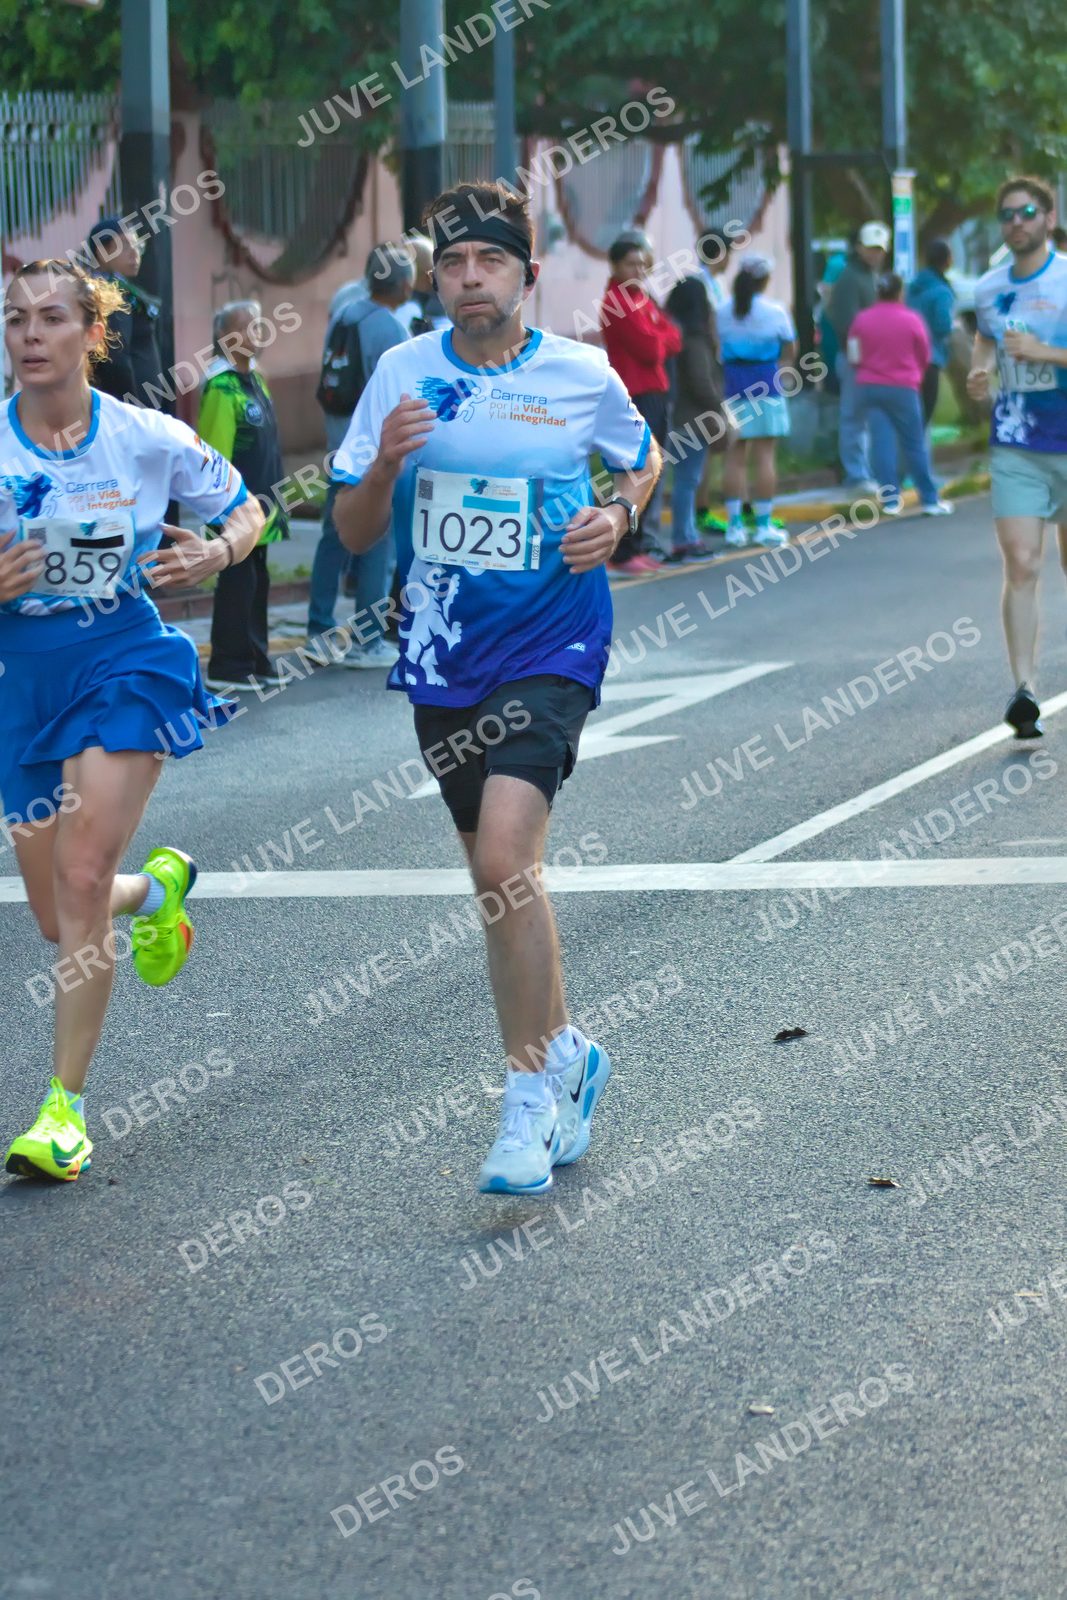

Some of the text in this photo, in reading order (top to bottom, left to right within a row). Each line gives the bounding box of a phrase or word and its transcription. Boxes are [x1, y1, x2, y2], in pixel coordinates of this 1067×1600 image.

[491, 388, 547, 404] Carrera
[490, 400, 548, 415] por la Vida
[497, 410, 506, 420] la
[510, 411, 567, 427] Integridad
[65, 479, 118, 494] Carrera
[98, 490, 121, 500] Vida
[420, 509, 521, 558] 1023
[45, 551, 121, 585] 859
